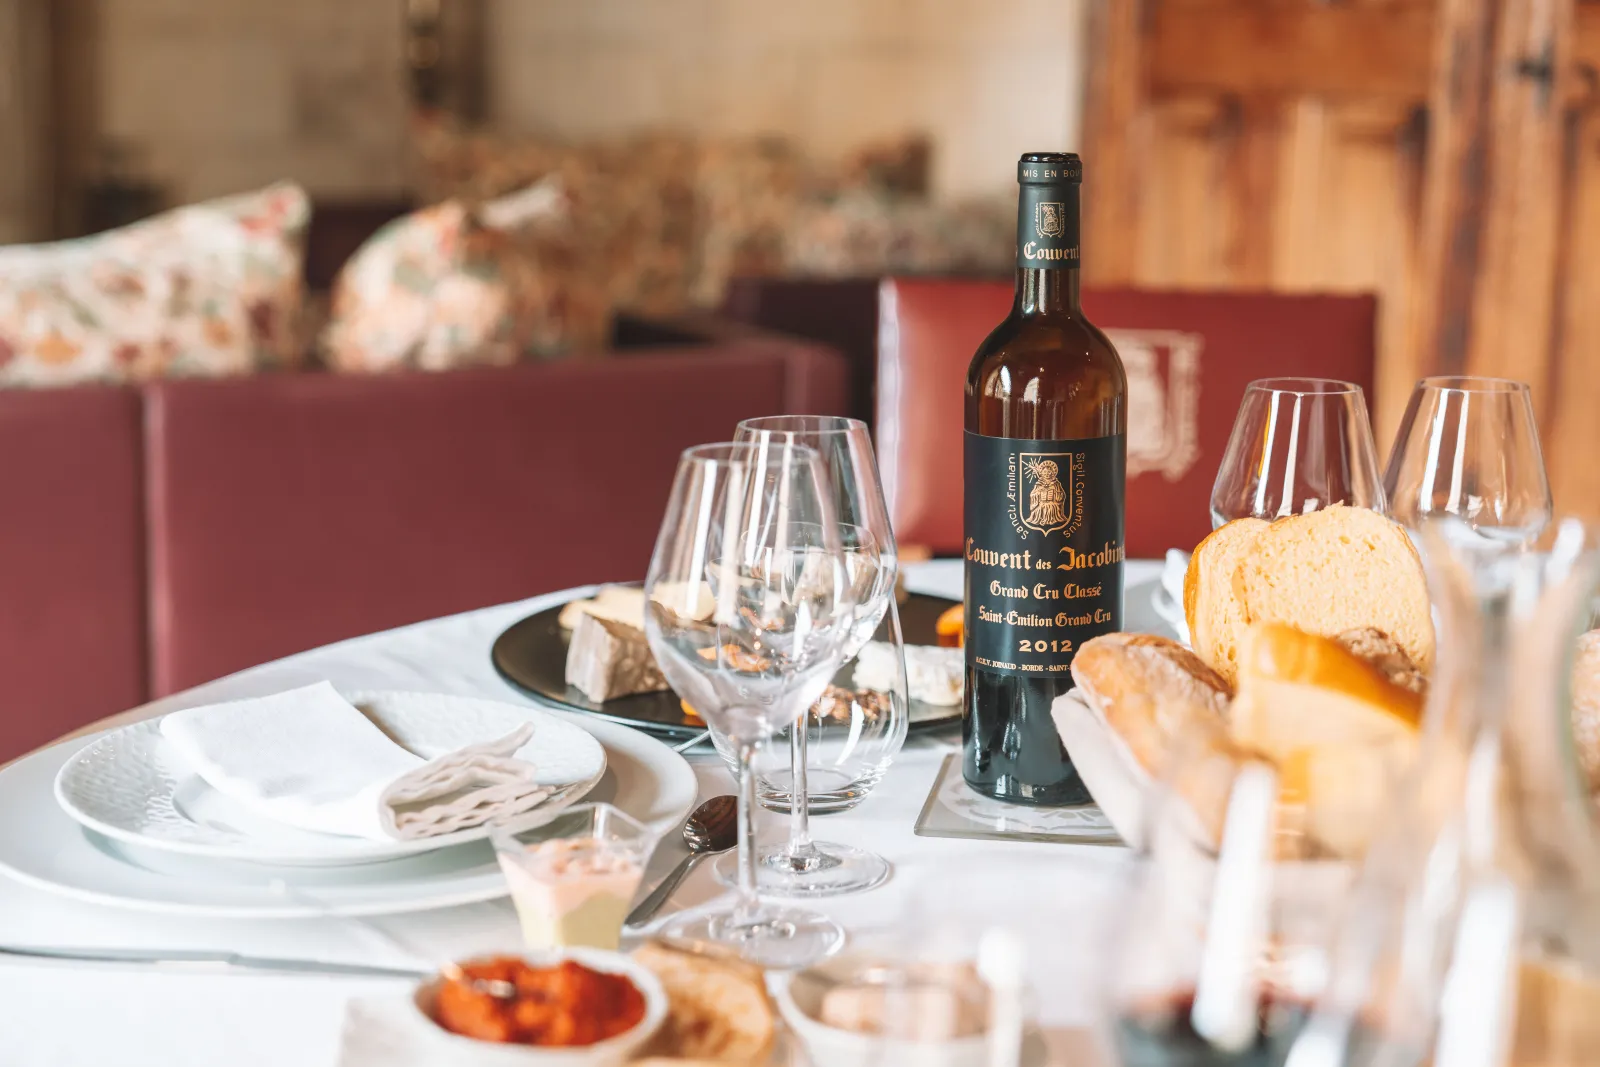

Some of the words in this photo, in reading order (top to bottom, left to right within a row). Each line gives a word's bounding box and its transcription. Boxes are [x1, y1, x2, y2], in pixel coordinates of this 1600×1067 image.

[1023, 169, 1038, 178] MIS
[1044, 169, 1057, 178] EN
[1023, 241, 1080, 260] Couvent
[965, 536, 1032, 571] Couvent
[1035, 558, 1052, 570] des
[989, 579, 1029, 599] Grand
[1033, 582, 1060, 600] Cru
[1063, 581, 1103, 599] Classé
[1054, 611, 1093, 628] Grand
[1094, 608, 1112, 624] Cru
[1018, 639, 1073, 653] 2012
